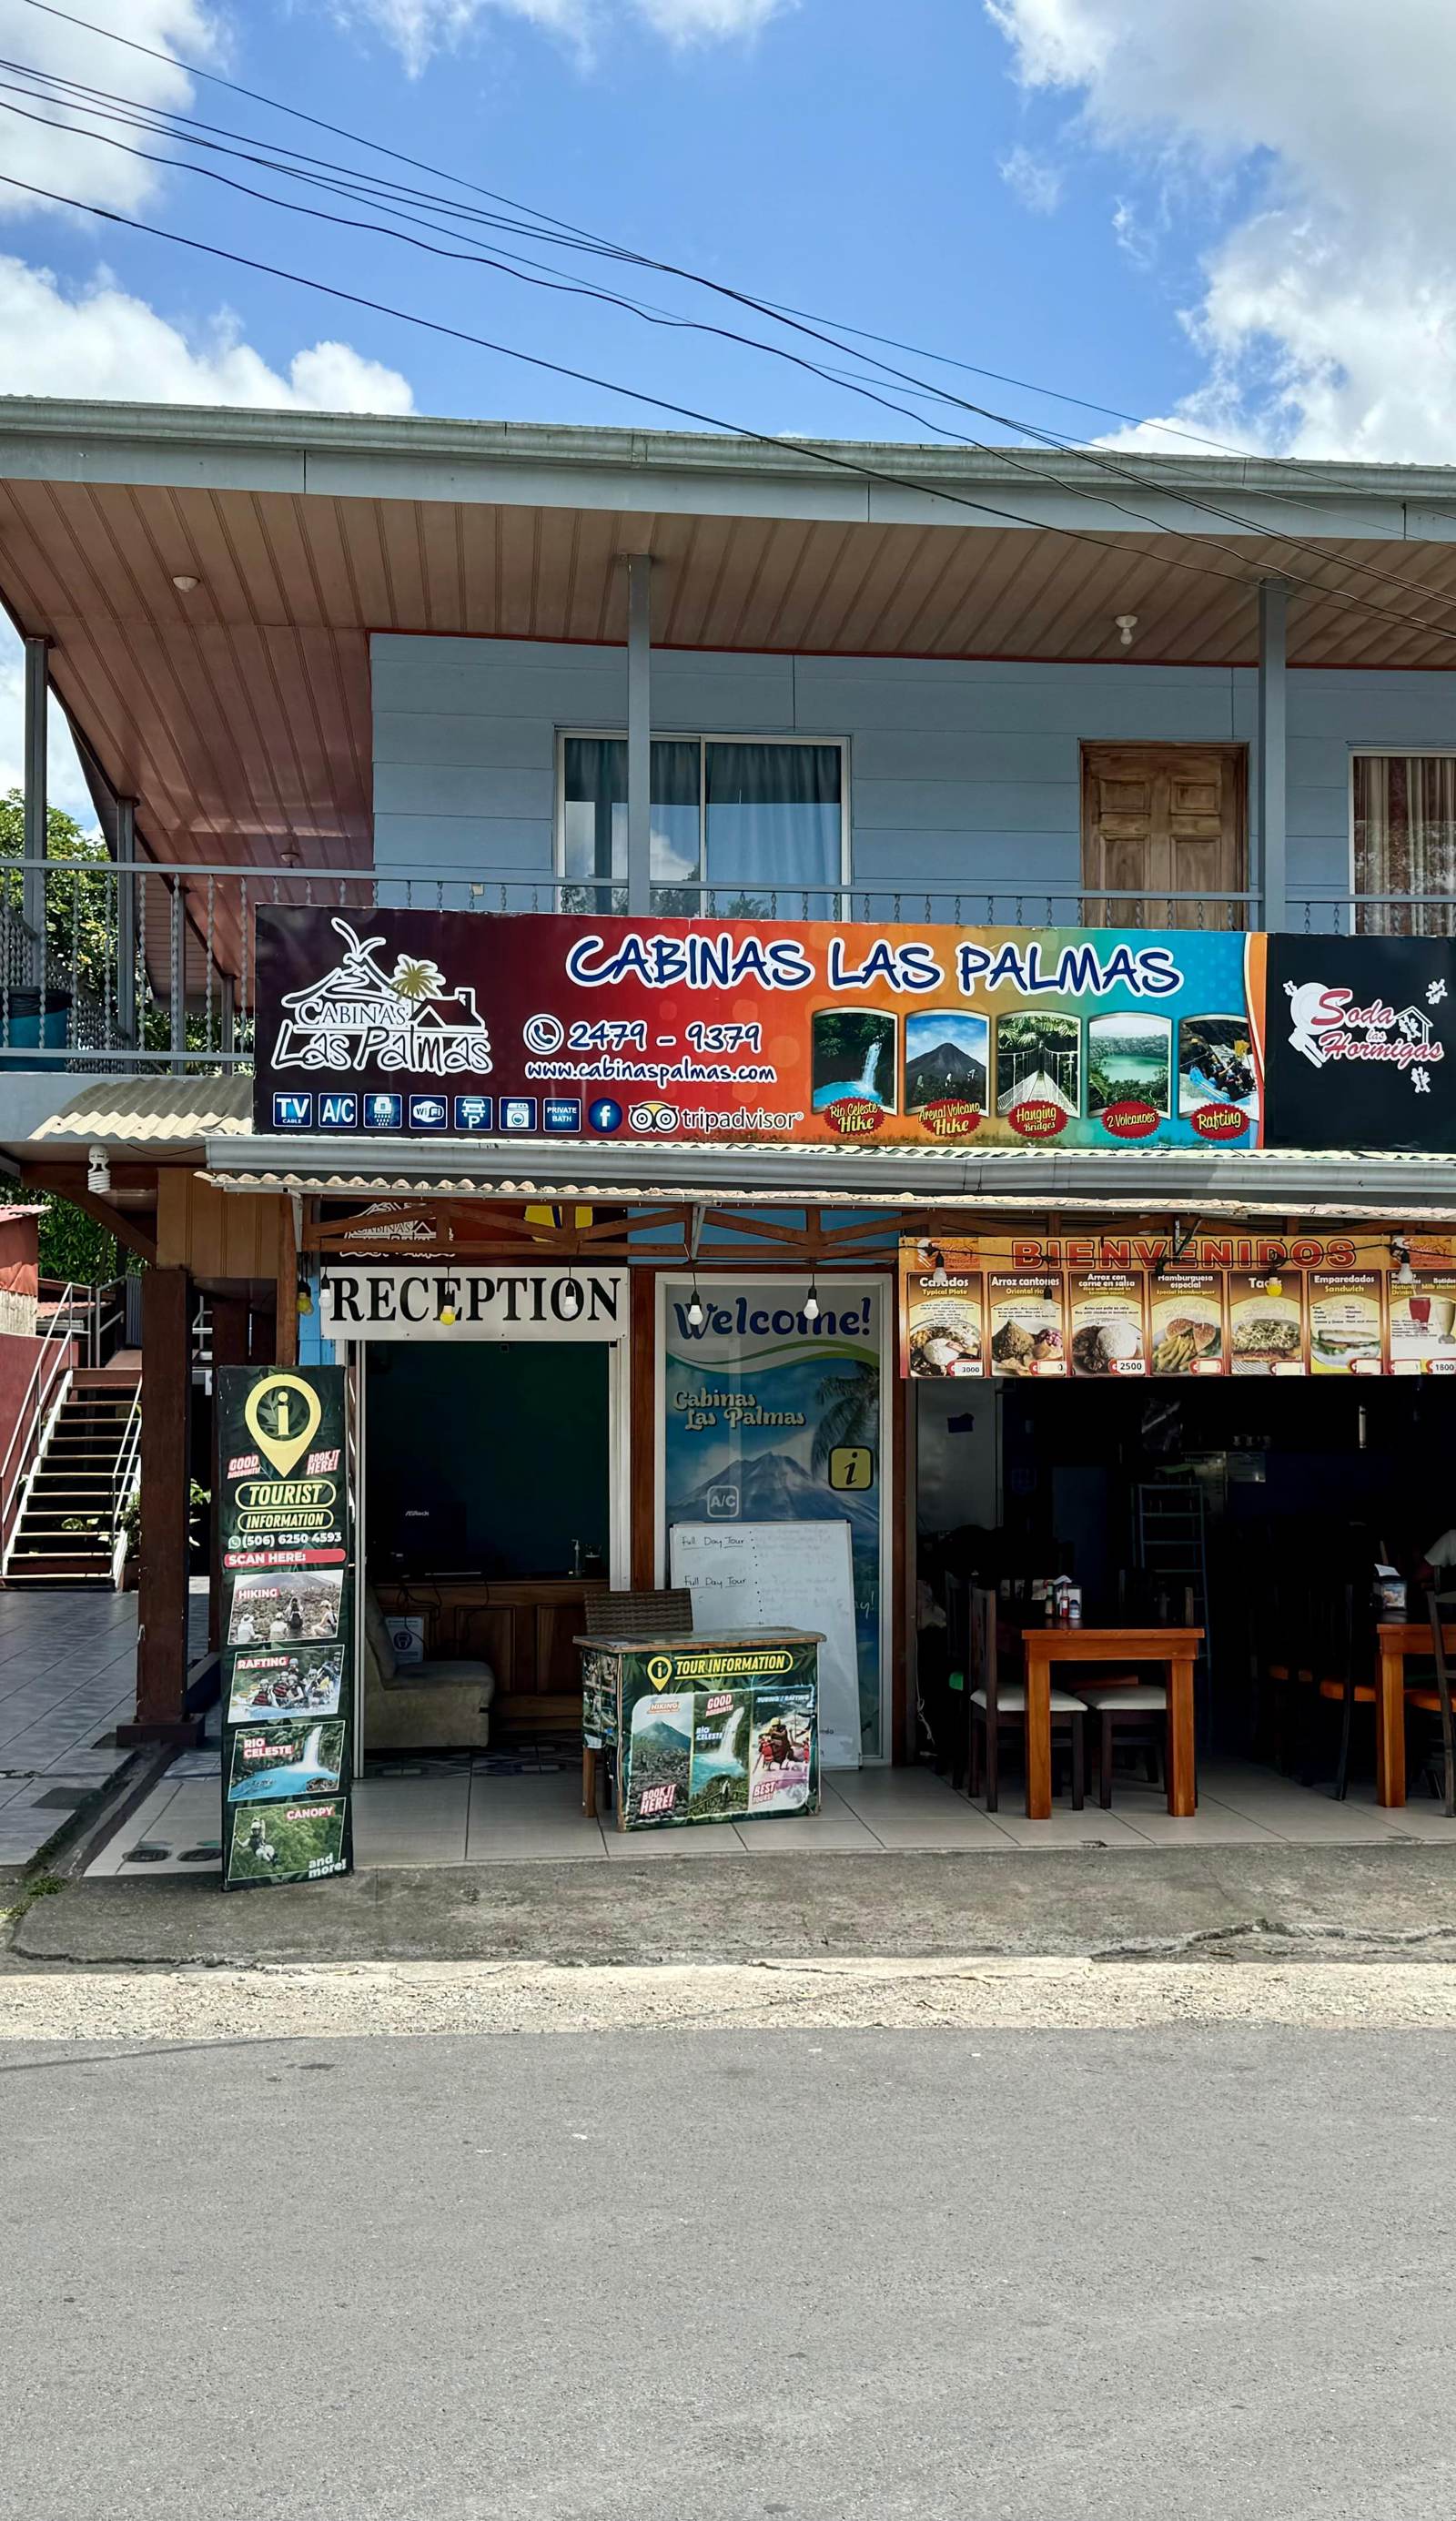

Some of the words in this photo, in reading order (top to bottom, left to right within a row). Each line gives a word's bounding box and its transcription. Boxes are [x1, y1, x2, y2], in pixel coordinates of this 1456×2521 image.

[566, 932, 814, 990] CABINAS
[828, 937, 945, 994] LAS
[956, 941, 1184, 997] PALMAS
[298, 1002, 407, 1026] CABINAS
[1310, 988, 1395, 1028] Soda
[568, 1019, 647, 1051] 2479
[686, 1021, 762, 1052] 9379
[1366, 1028, 1387, 1042] las
[271, 1019, 355, 1071] Las
[353, 1026, 492, 1076] Palmas
[1319, 1030, 1444, 1069] Hormigas
[525, 1055, 777, 1088] www.cabinaspalmas.com
[277, 1098, 309, 1118] TV
[322, 1099, 354, 1122] A/C
[546, 1106, 577, 1114] PRIVATE
[847, 1102, 878, 1117] Celeste
[918, 1108, 946, 1121] Arenal
[947, 1102, 980, 1117] Volcano
[1016, 1105, 1057, 1125] Hanging
[468, 1116, 481, 1129] P
[838, 1117, 875, 1133] Hike
[933, 1119, 969, 1136] Hike
[1023, 1121, 1056, 1133] Bridges
[1107, 1115, 1114, 1129] 2
[1115, 1112, 1156, 1127] Volcanoes
[1197, 1110, 1241, 1131] Rafting
[1012, 1239, 1357, 1270] BIENVENIDOS
[991, 1277, 1017, 1286] Arroz
[1158, 1274, 1213, 1282] Hamburguesa
[1314, 1275, 1374, 1284] Emparedados
[329, 1277, 622, 1321] RECEPTION
[672, 1297, 872, 1340] Welcome!
[1119, 1362, 1142, 1371] 2500
[673, 1387, 755, 1410] Cabinas
[685, 1410, 717, 1431] Las
[723, 1406, 805, 1428] Palmas
[228, 1454, 259, 1472] GOOD
[308, 1452, 332, 1463] BOOK
[307, 1459, 339, 1474] HERE!
[248, 1483, 323, 1505] TOURIST
[710, 1494, 735, 1507] A/C
[247, 1513, 324, 1528] INFORMATION
[242, 1534, 275, 1547] (506)
[278, 1533, 308, 1544] 6250
[312, 1532, 342, 1543] 4593
[704, 1536, 722, 1548] Day
[725, 1536, 743, 1544] Tour
[228, 1554, 265, 1564] SCAN
[268, 1553, 306, 1563] HERE:
[684, 1575, 699, 1585] Full
[705, 1576, 723, 1587] Day
[726, 1576, 746, 1585] Tour
[238, 1588, 278, 1599] HIKING
[237, 1656, 288, 1669] RAFTING
[676, 1659, 706, 1676] TOUR
[708, 1655, 785, 1673] INFORMATION
[707, 1694, 732, 1709] GOOD
[244, 1739, 265, 1748] RIO
[244, 1746, 292, 1757] CELESTE
[642, 1787, 666, 1799] BOOK
[754, 1781, 775, 1797] BEST
[641, 1795, 674, 1814] HERE!
[287, 1807, 333, 1820] CANOPY
[308, 1852, 333, 1868] and
[308, 1858, 347, 1878] more!
